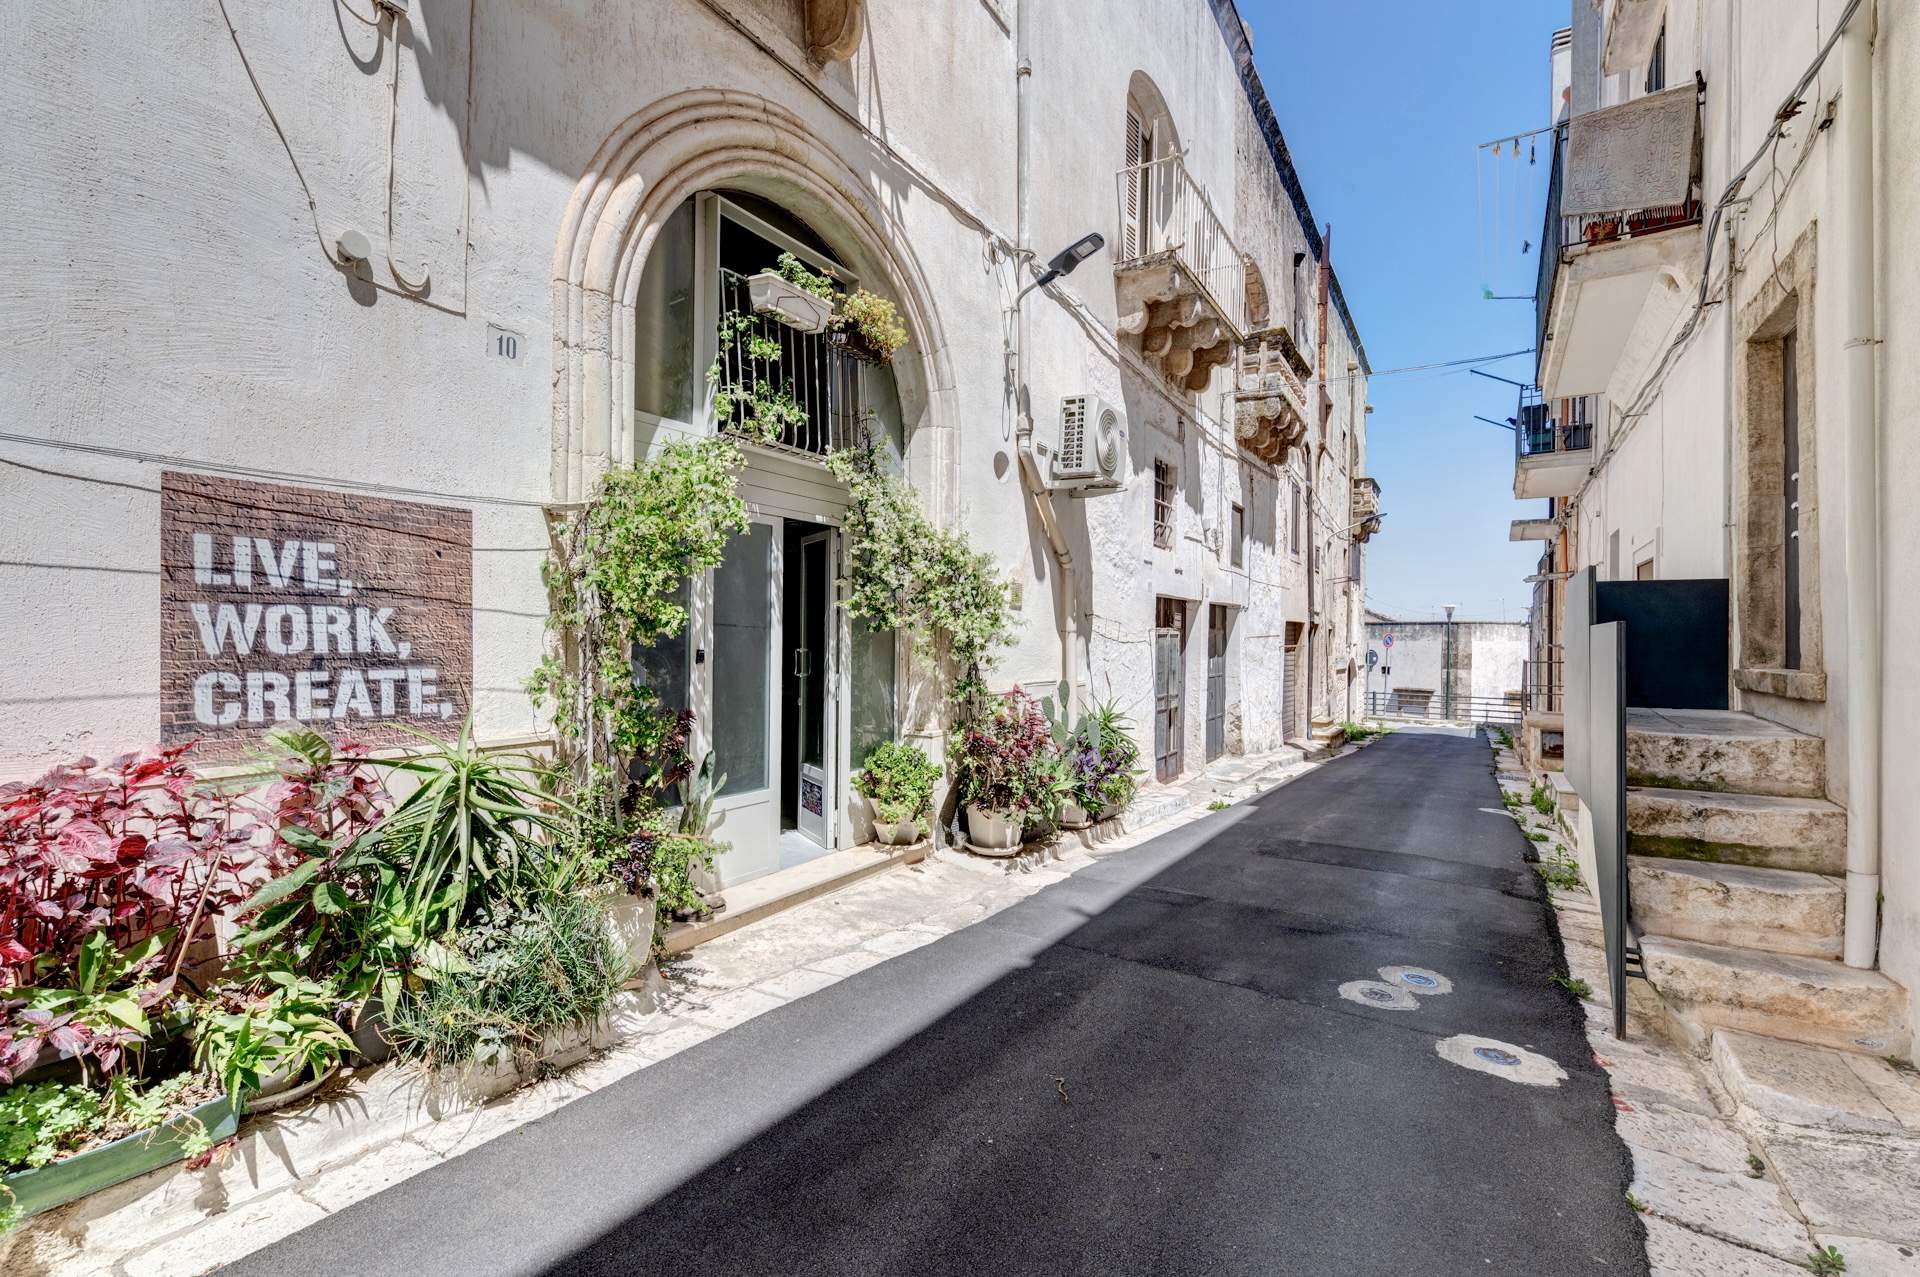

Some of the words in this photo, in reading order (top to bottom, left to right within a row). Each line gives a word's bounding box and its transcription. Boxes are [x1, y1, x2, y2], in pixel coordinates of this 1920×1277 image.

[496, 334, 517, 360] 10
[192, 533, 353, 597] LIVE,
[190, 602, 411, 659] WORK,
